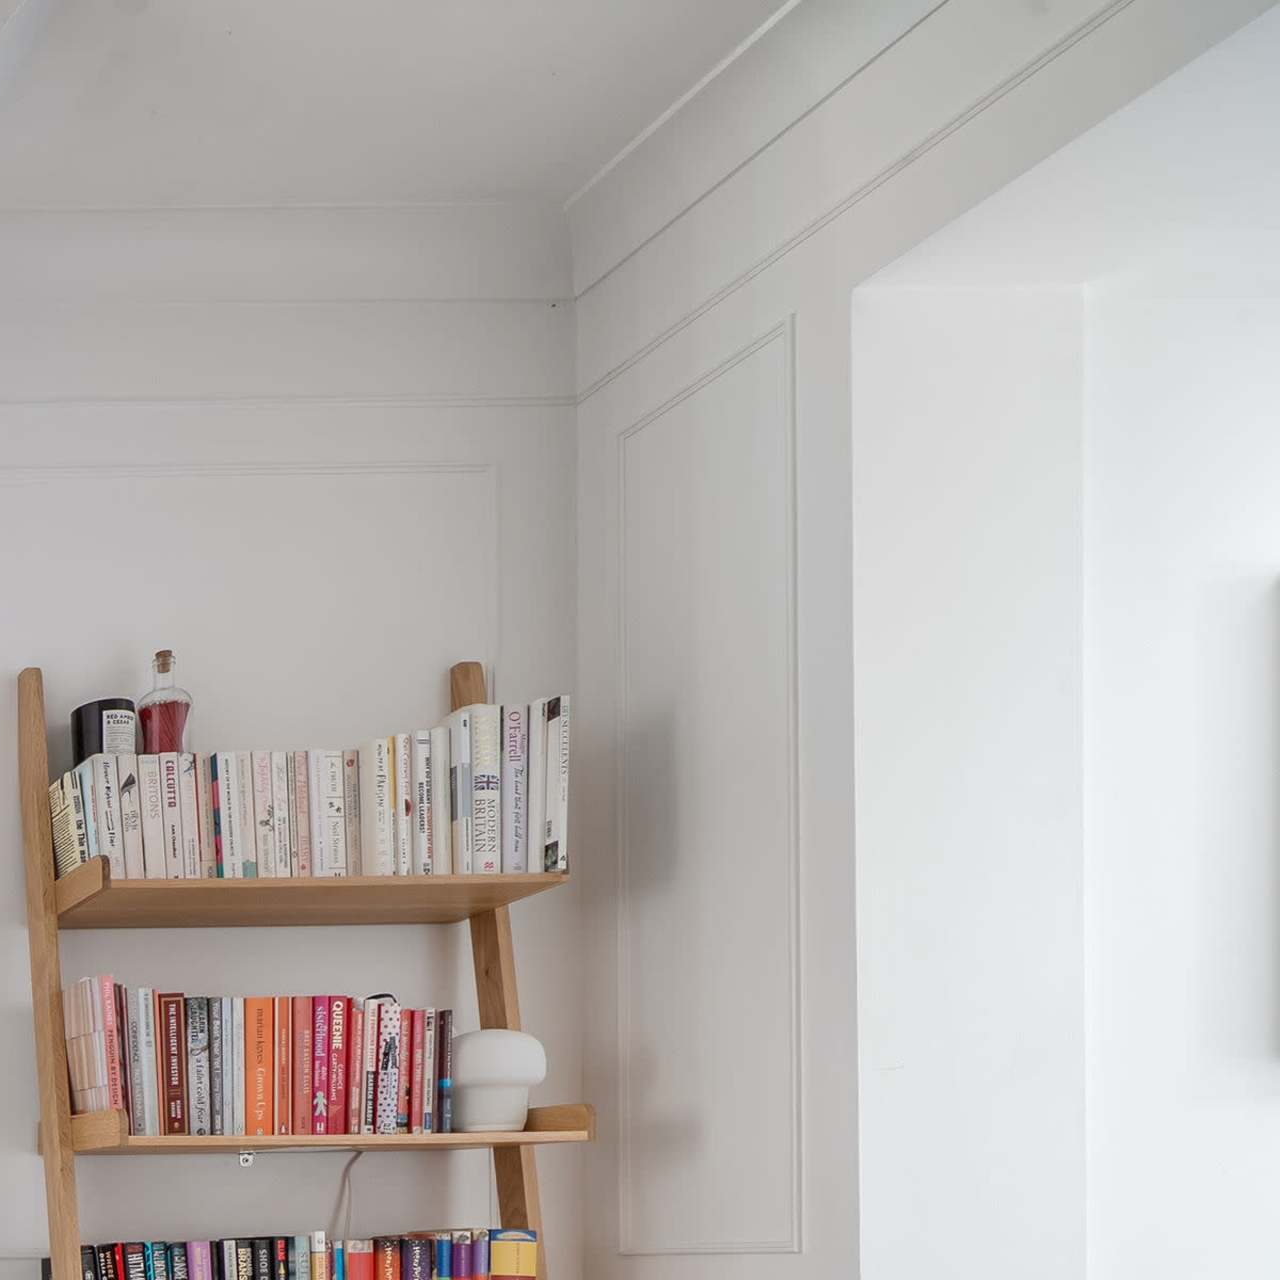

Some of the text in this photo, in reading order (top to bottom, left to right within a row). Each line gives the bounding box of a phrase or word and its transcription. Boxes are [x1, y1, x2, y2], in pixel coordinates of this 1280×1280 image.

[509, 711, 521, 762] O'Farrell
[148, 772, 160, 820] BRITONS
[166, 760, 177, 808] CALCUTTA
[331, 821, 341, 864] Neil Strauss
[475, 799, 486, 852] BRITAIN
[487, 798, 496, 852] MODERN
[315, 1006, 327, 1056] sisterhood
[332, 1001, 343, 1050] QUEENIE
[110, 1066, 116, 1075] BY
[255, 1009, 265, 1120] marian keyes Grown Ups
[195, 1107, 205, 1123] fear
[197, 1087, 205, 1105] cold
[105, 1251, 114, 1279] WHERE
[259, 1249, 268, 1273] SHOE
